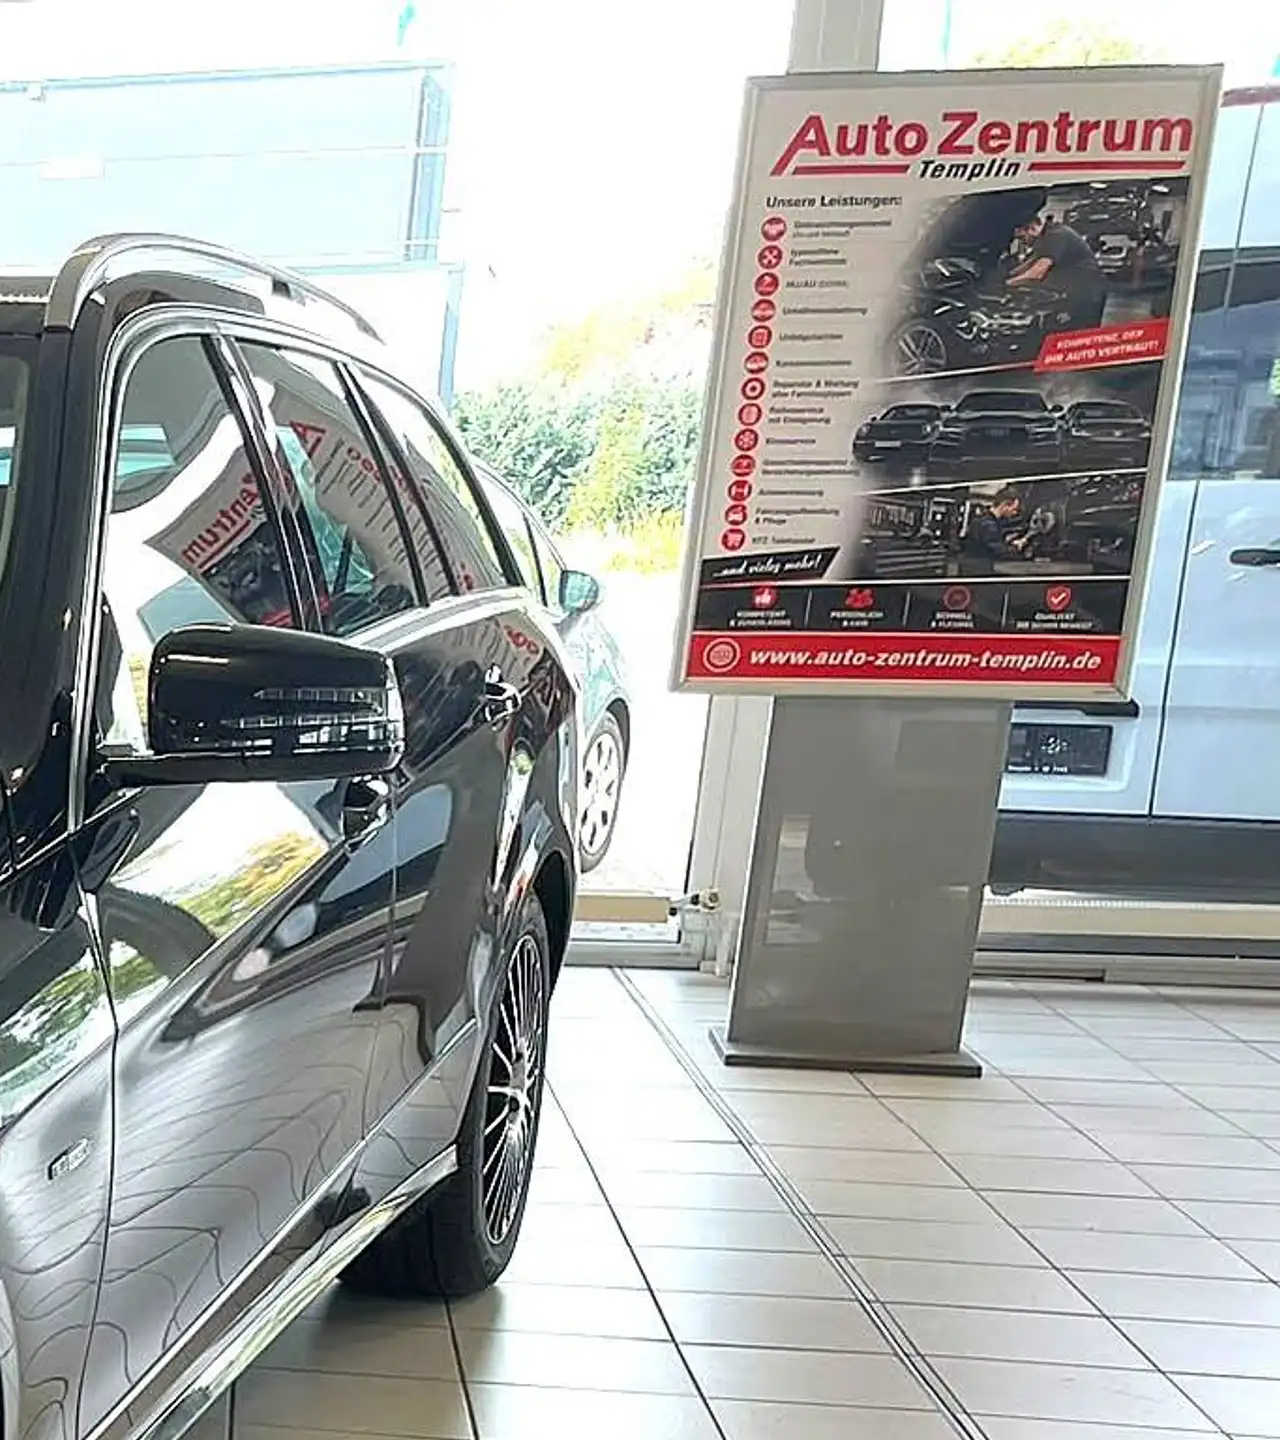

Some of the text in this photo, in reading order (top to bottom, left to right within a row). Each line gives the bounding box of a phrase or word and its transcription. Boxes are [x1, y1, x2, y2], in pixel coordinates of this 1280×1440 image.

[770, 111, 1193, 177] Auto Zentrum
[917, 157, 1021, 181] Templin
[766, 194, 904, 209] Unsere Leistungen:
[748, 649, 1102, 672] www.auto-zentrum-templin.de
